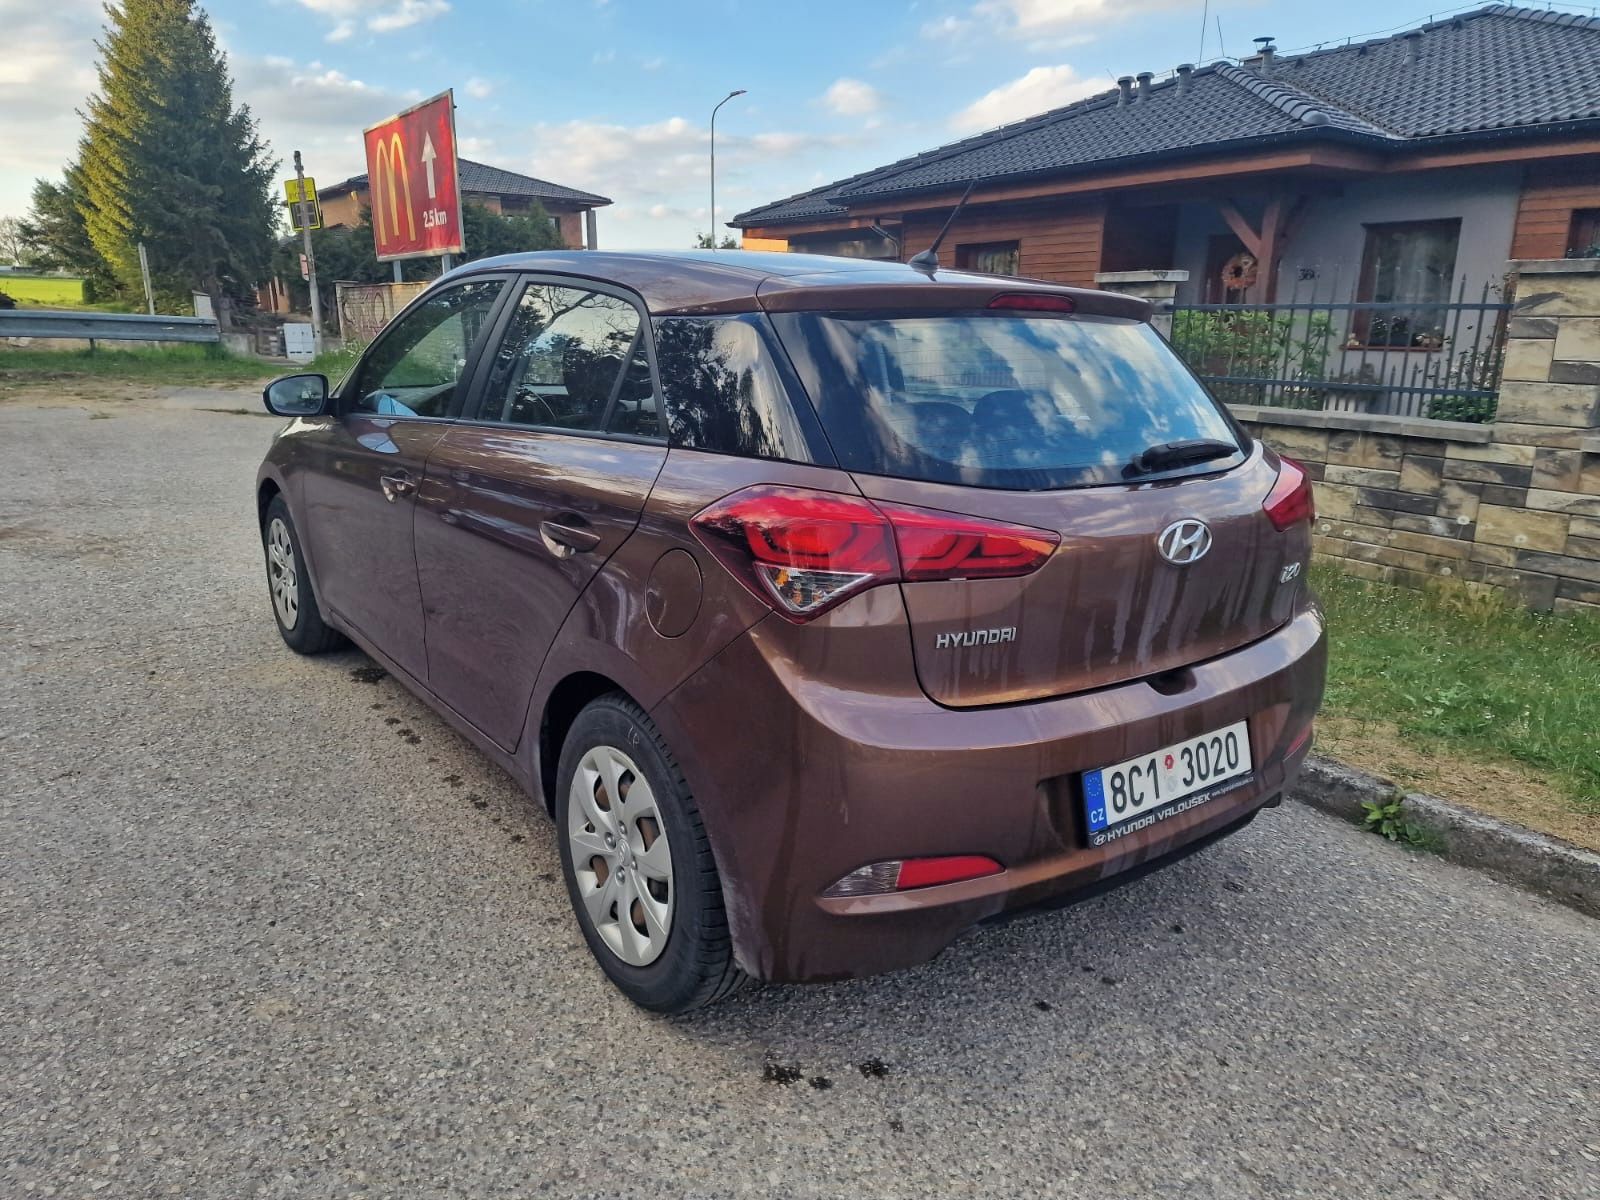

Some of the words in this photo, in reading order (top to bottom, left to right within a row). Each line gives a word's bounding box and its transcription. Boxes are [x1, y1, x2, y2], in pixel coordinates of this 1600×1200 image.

[434, 207, 447, 226] km
[1280, 562, 1300, 583] i20
[936, 627, 1017, 649] HYUNDAI
[1110, 758, 1160, 814] 8C1
[1181, 731, 1239, 787] 3020
[1091, 808, 1104, 824] CZ
[1107, 815, 1155, 842] HYUNDAI
